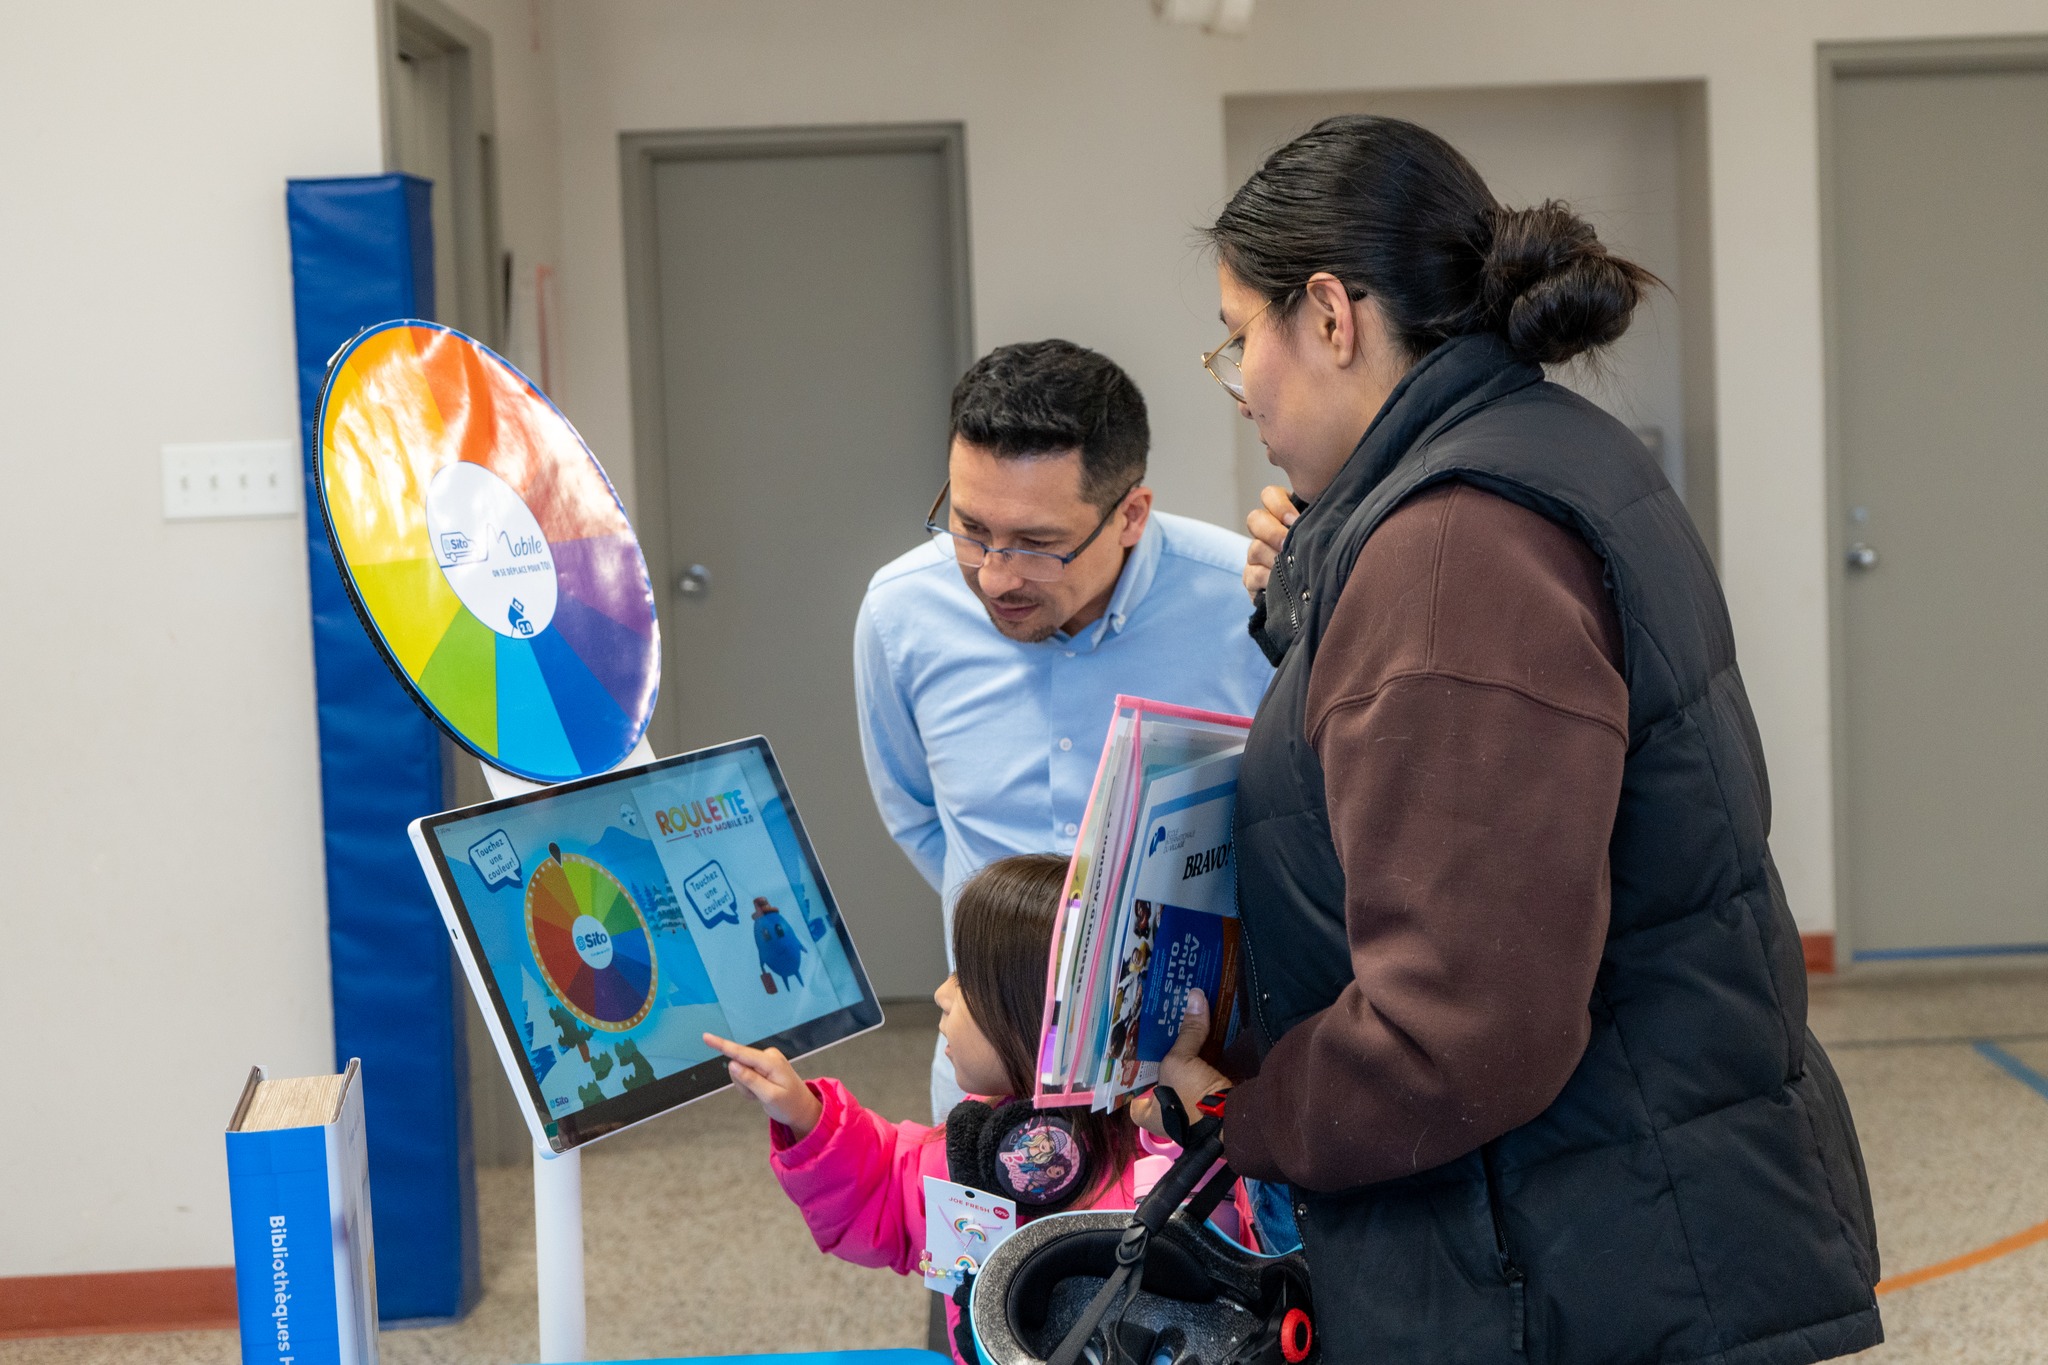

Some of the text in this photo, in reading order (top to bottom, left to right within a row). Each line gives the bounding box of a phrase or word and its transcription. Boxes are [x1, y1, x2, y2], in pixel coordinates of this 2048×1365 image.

[450, 539, 469, 550] Sito
[655, 789, 749, 836] ROULETTE
[693, 814, 754, 839] SITO MOBILE 2.0
[475, 838, 505, 858] Touchez
[489, 853, 503, 866] une
[488, 857, 516, 880] couleur!
[1182, 841, 1232, 880] BRAVO!
[690, 870, 719, 893] Touchez
[704, 886, 718, 899] une
[584, 931, 608, 948] Sito
[1076, 923, 1093, 994] SESSION
[1188, 936, 1200, 967] CV
[1158, 941, 1180, 1025] Le SITO
[1167, 933, 1192, 1037] c'est plus
[555, 1096, 569, 1107] Sito
[949, 1197, 990, 1213] JOE FRESH
[269, 1215, 291, 1352] Bibliothèques
